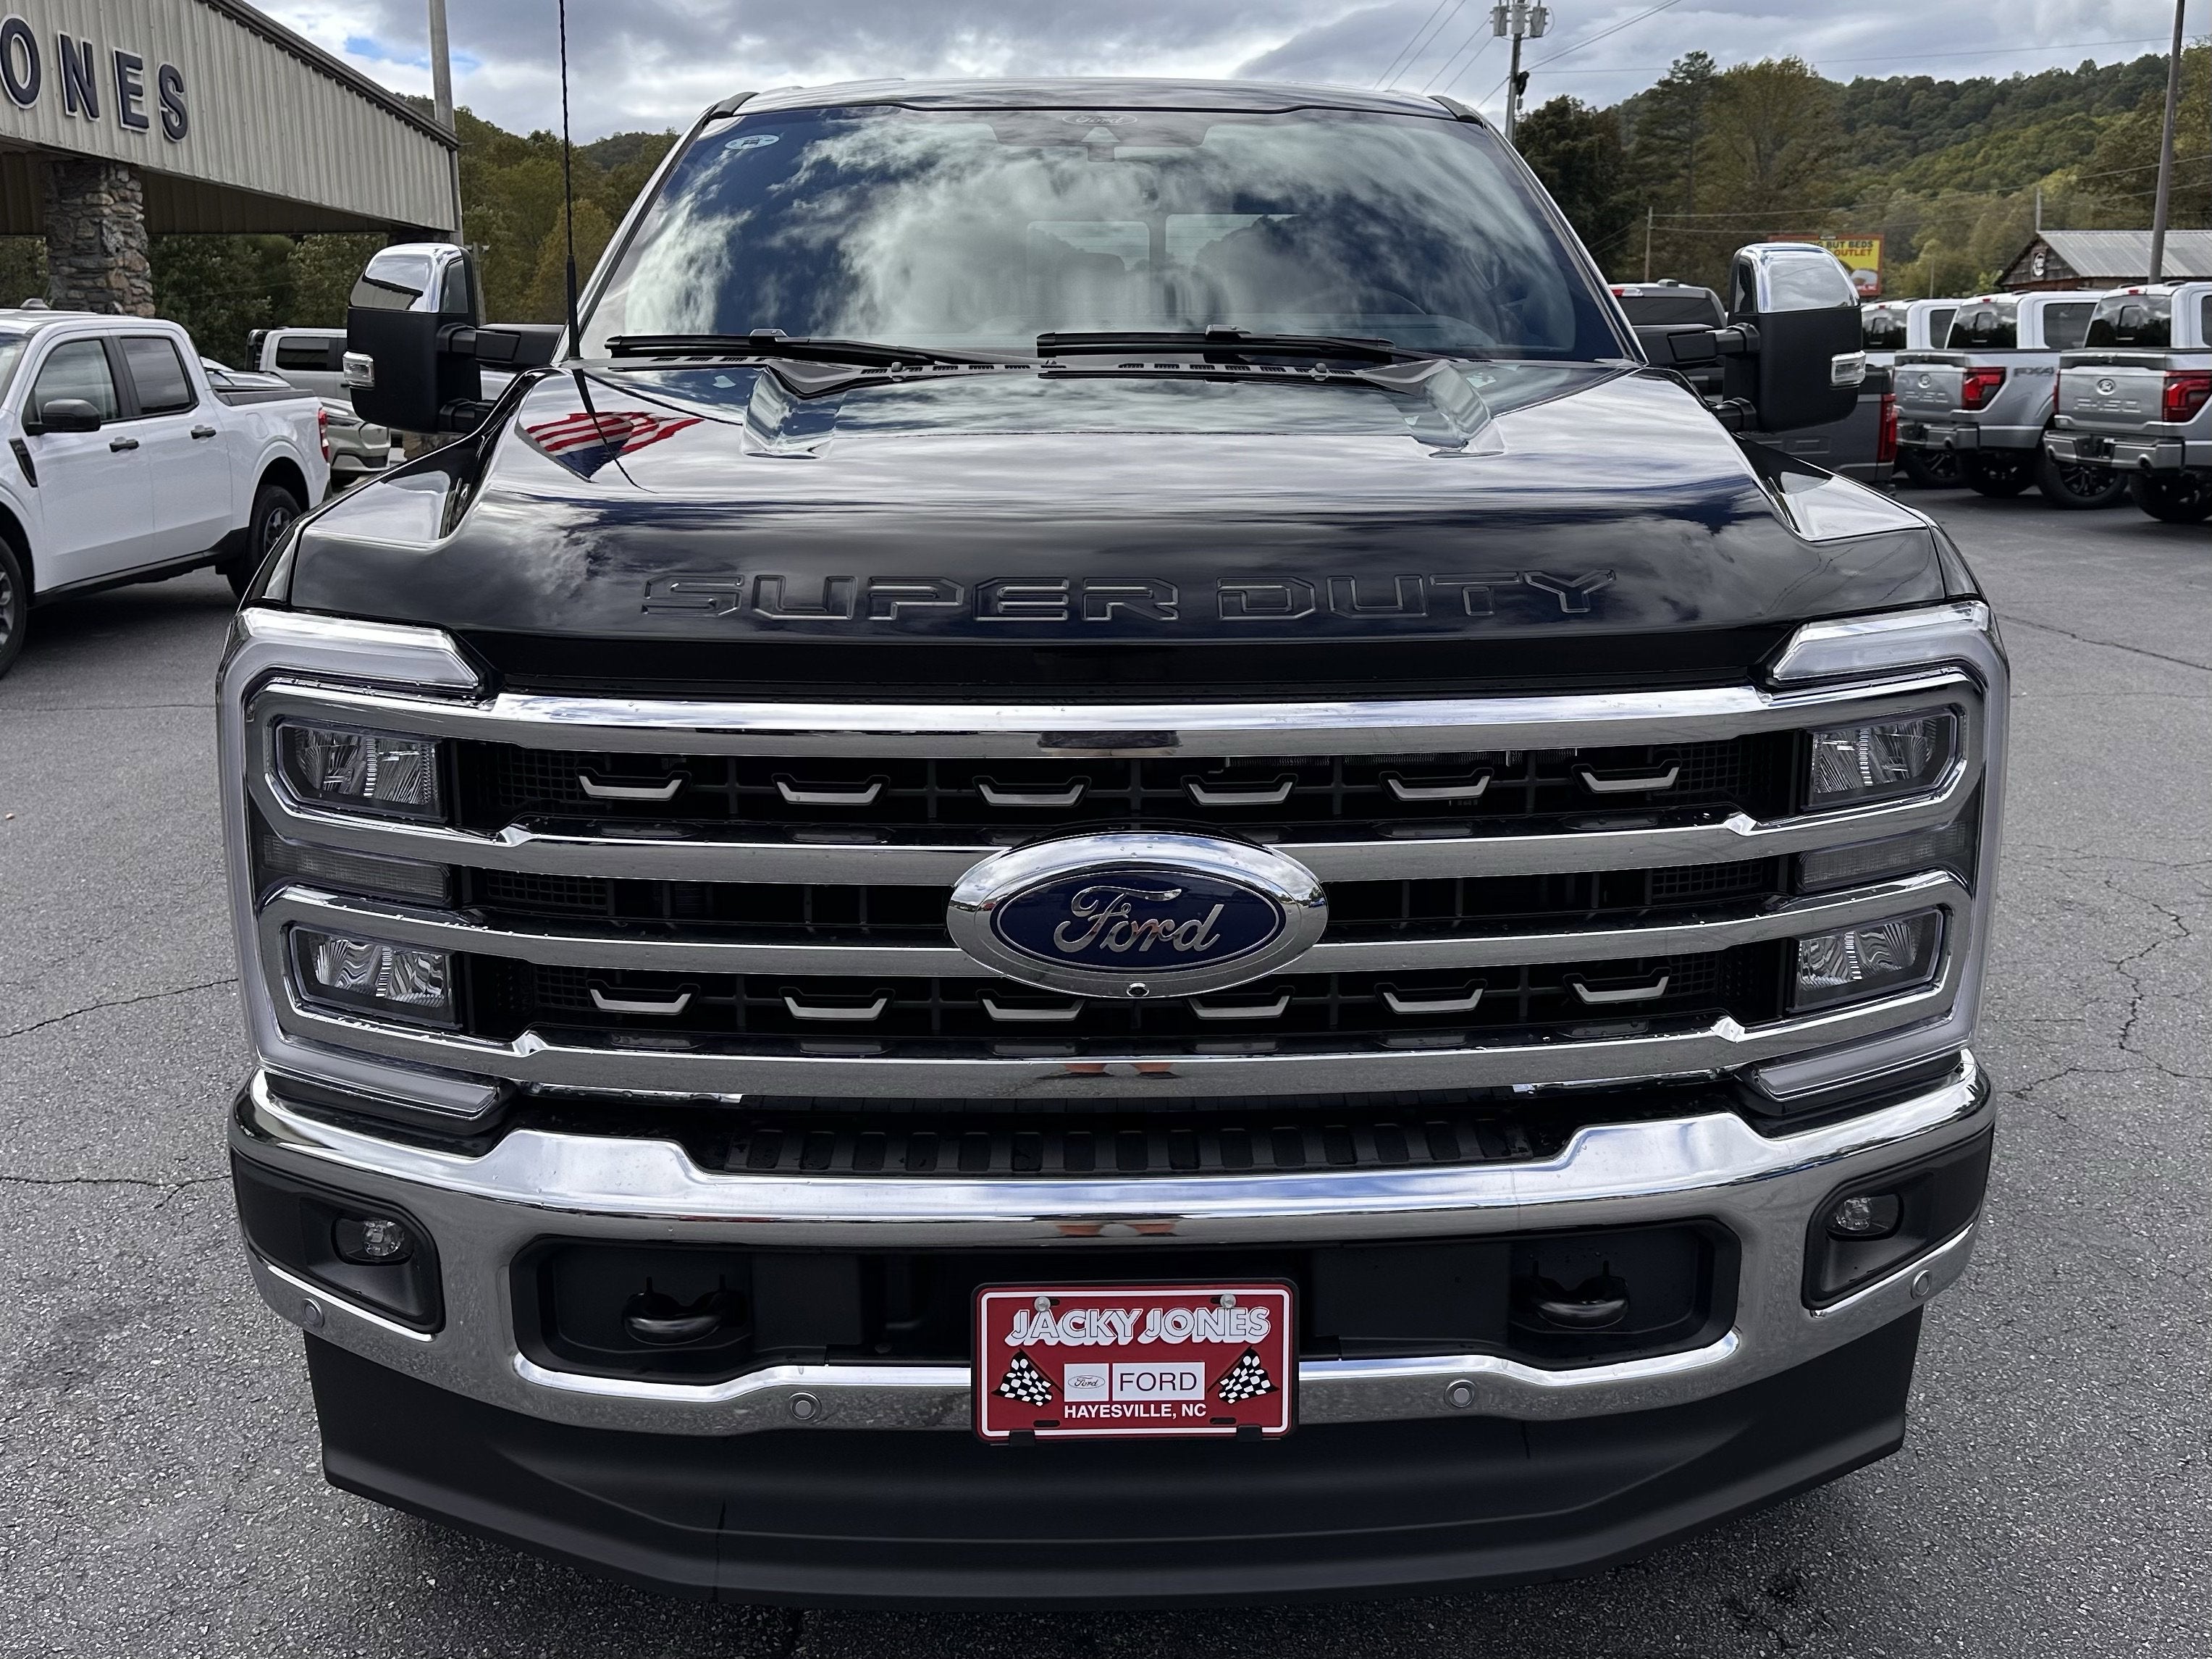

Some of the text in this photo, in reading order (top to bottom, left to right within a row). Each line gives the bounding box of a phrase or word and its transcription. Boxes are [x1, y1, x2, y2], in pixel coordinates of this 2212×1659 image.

[641, 568, 1617, 621] SUPER DUTY
[1054, 885, 1224, 953] Ford
[1004, 1306, 1271, 1346] JACKY JONES
[1074, 1372, 1197, 1392] Ford FORD
[1064, 1403, 1207, 1420] HAYESVILLE, NC
